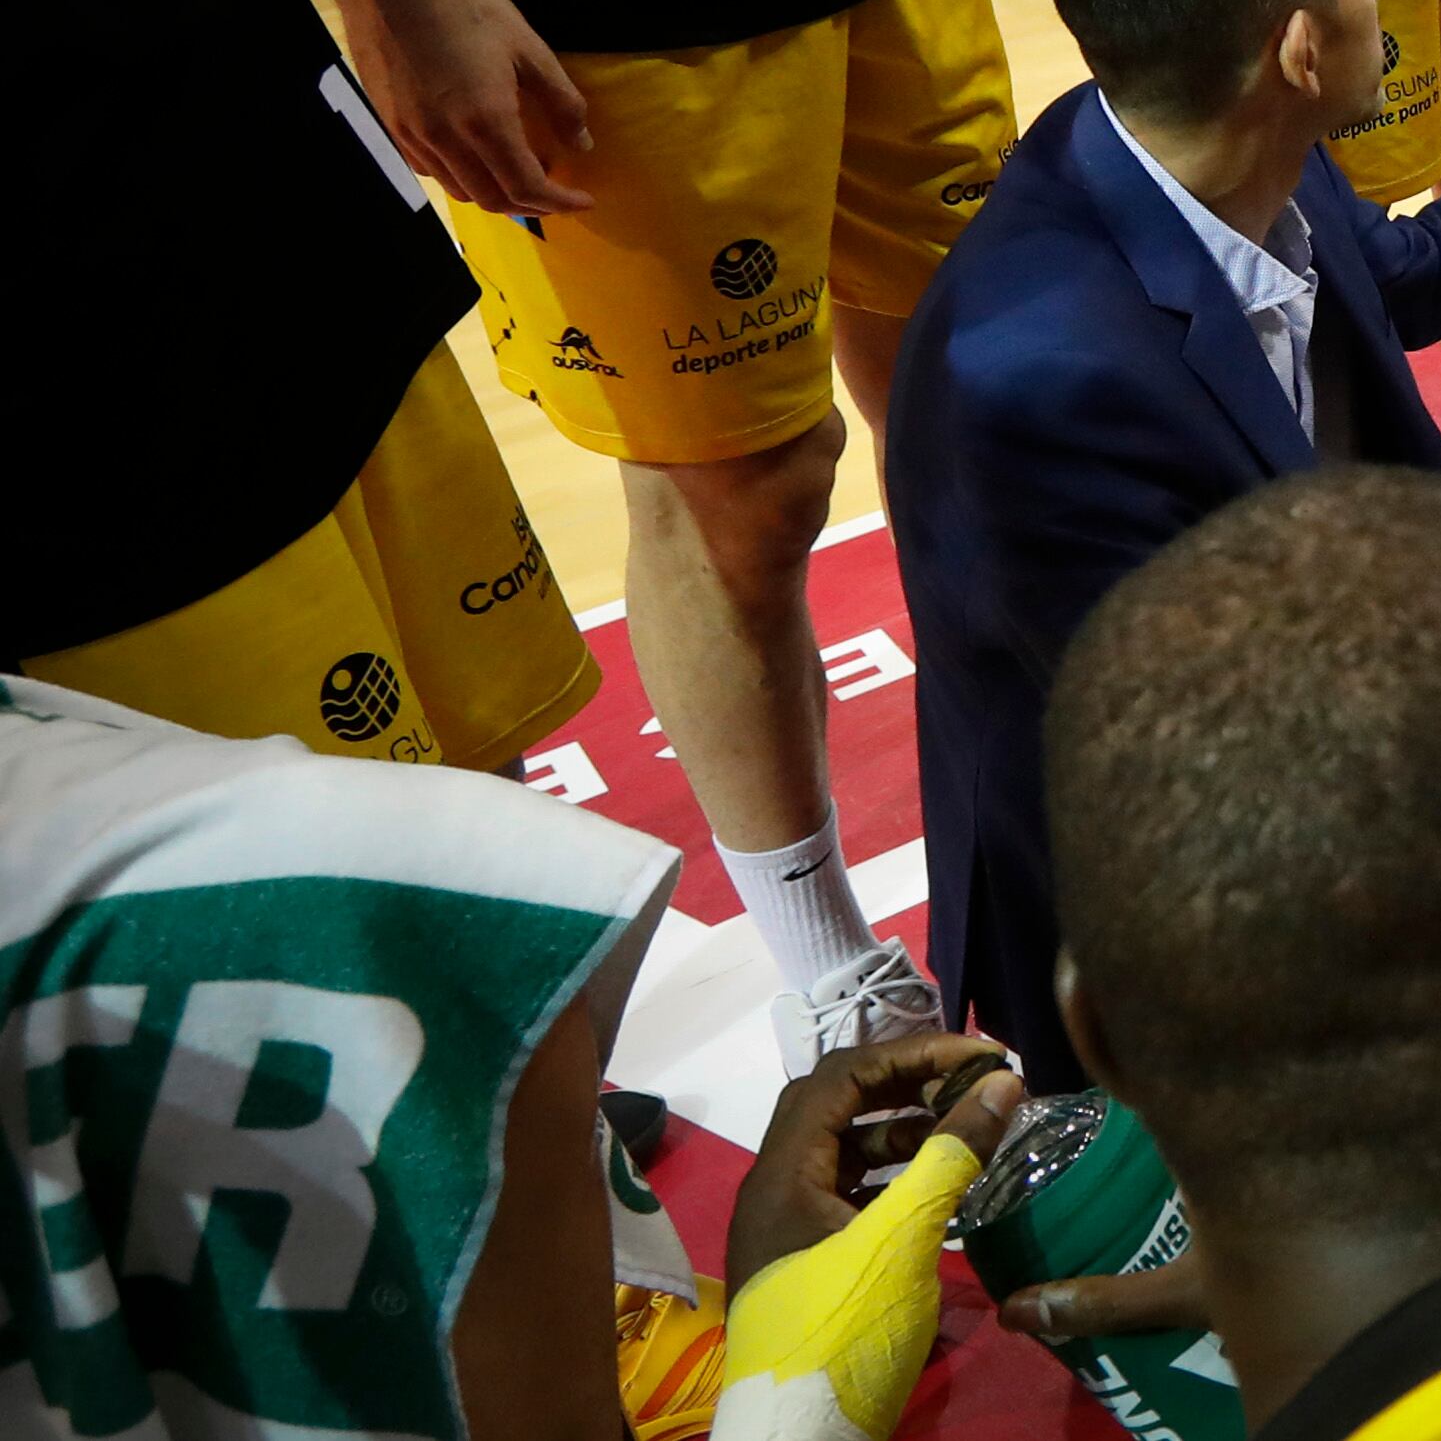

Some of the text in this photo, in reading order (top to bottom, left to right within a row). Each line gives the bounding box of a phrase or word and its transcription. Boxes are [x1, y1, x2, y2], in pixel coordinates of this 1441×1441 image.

[1385, 67, 1439, 104] GUNA
[1399, 97, 1432, 124] para
[662, 323, 709, 352] LA
[672, 318, 817, 375] deporte par
